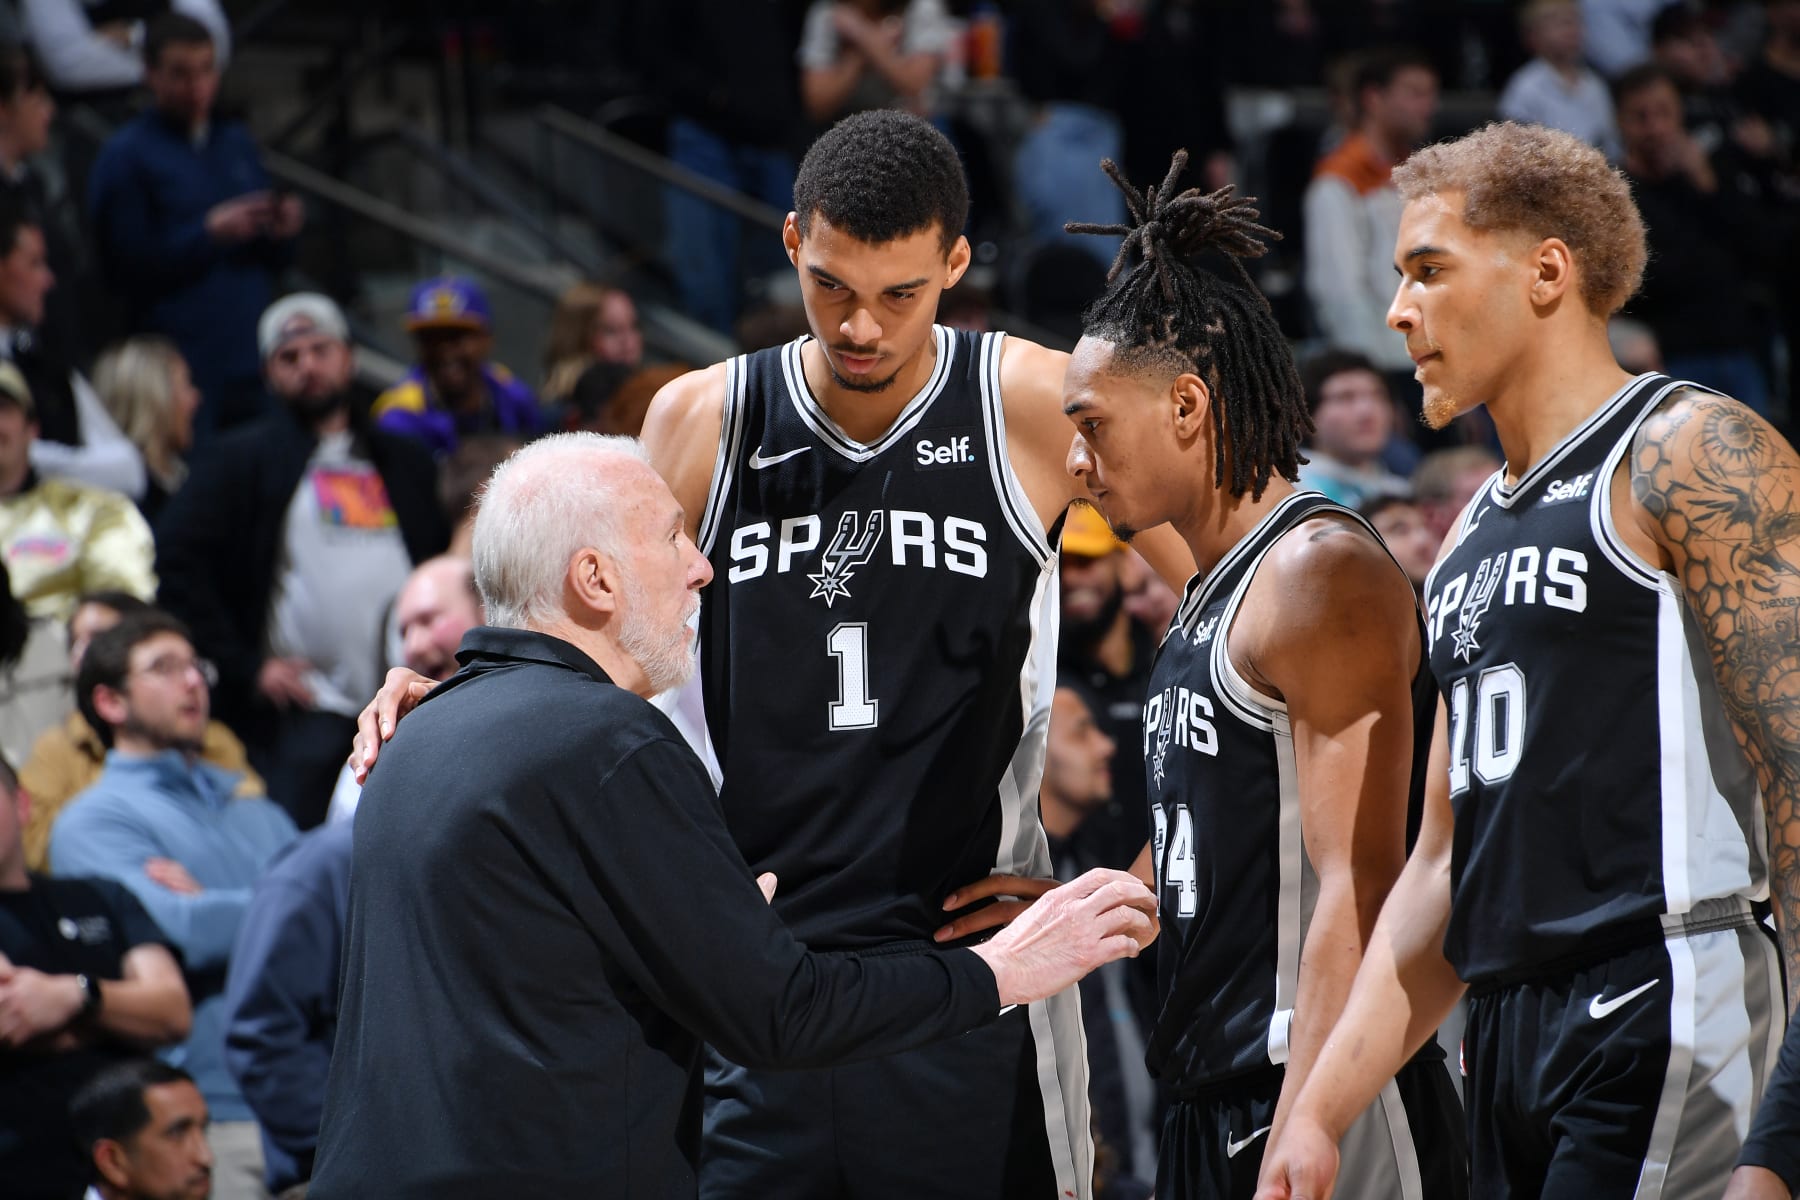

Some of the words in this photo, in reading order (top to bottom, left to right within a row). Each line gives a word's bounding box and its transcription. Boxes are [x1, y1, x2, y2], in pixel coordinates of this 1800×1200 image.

[916, 436, 975, 466] Self.
[1541, 473, 1594, 503] Self.
[728, 509, 988, 608] SPURS
[1760, 596, 1800, 610] neve
[826, 621, 879, 731] 1
[1143, 685, 1219, 791] PURS
[1449, 661, 1527, 800] 10
